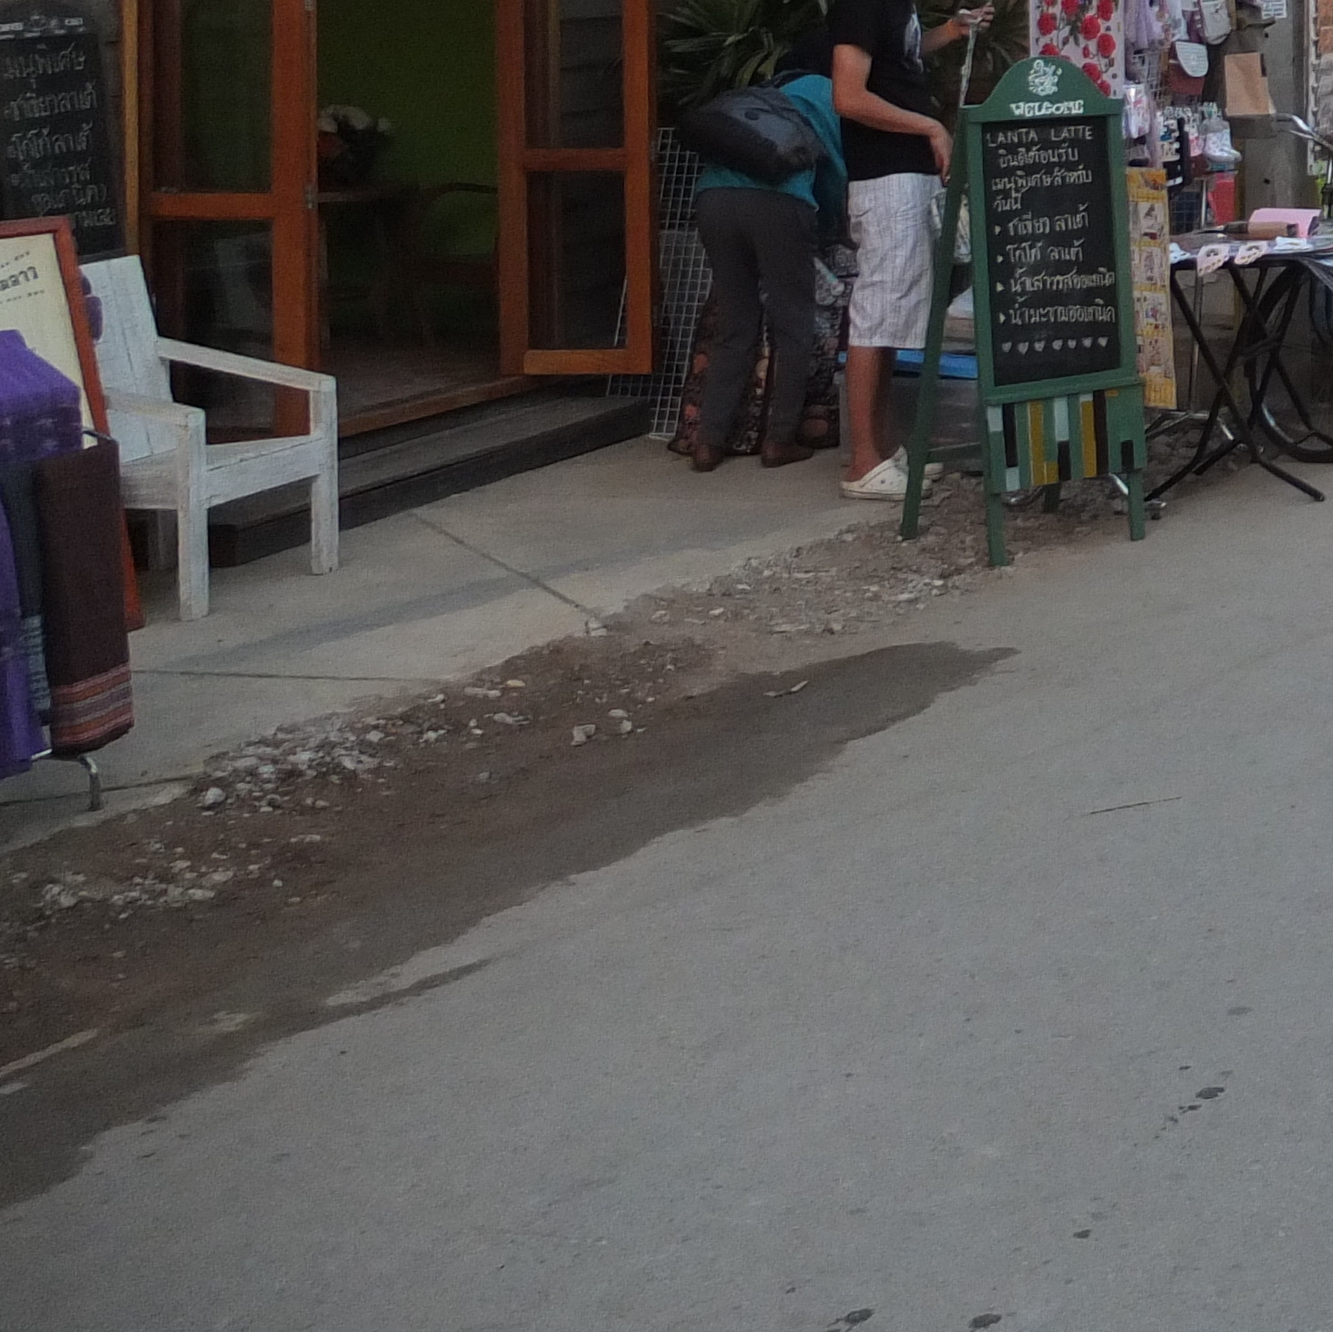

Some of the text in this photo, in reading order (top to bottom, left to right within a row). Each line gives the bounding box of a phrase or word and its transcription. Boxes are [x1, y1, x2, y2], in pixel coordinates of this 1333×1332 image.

[1009, 99, 1085, 117] WELCOME
[986, 125, 1094, 147] LANTA LATTE
